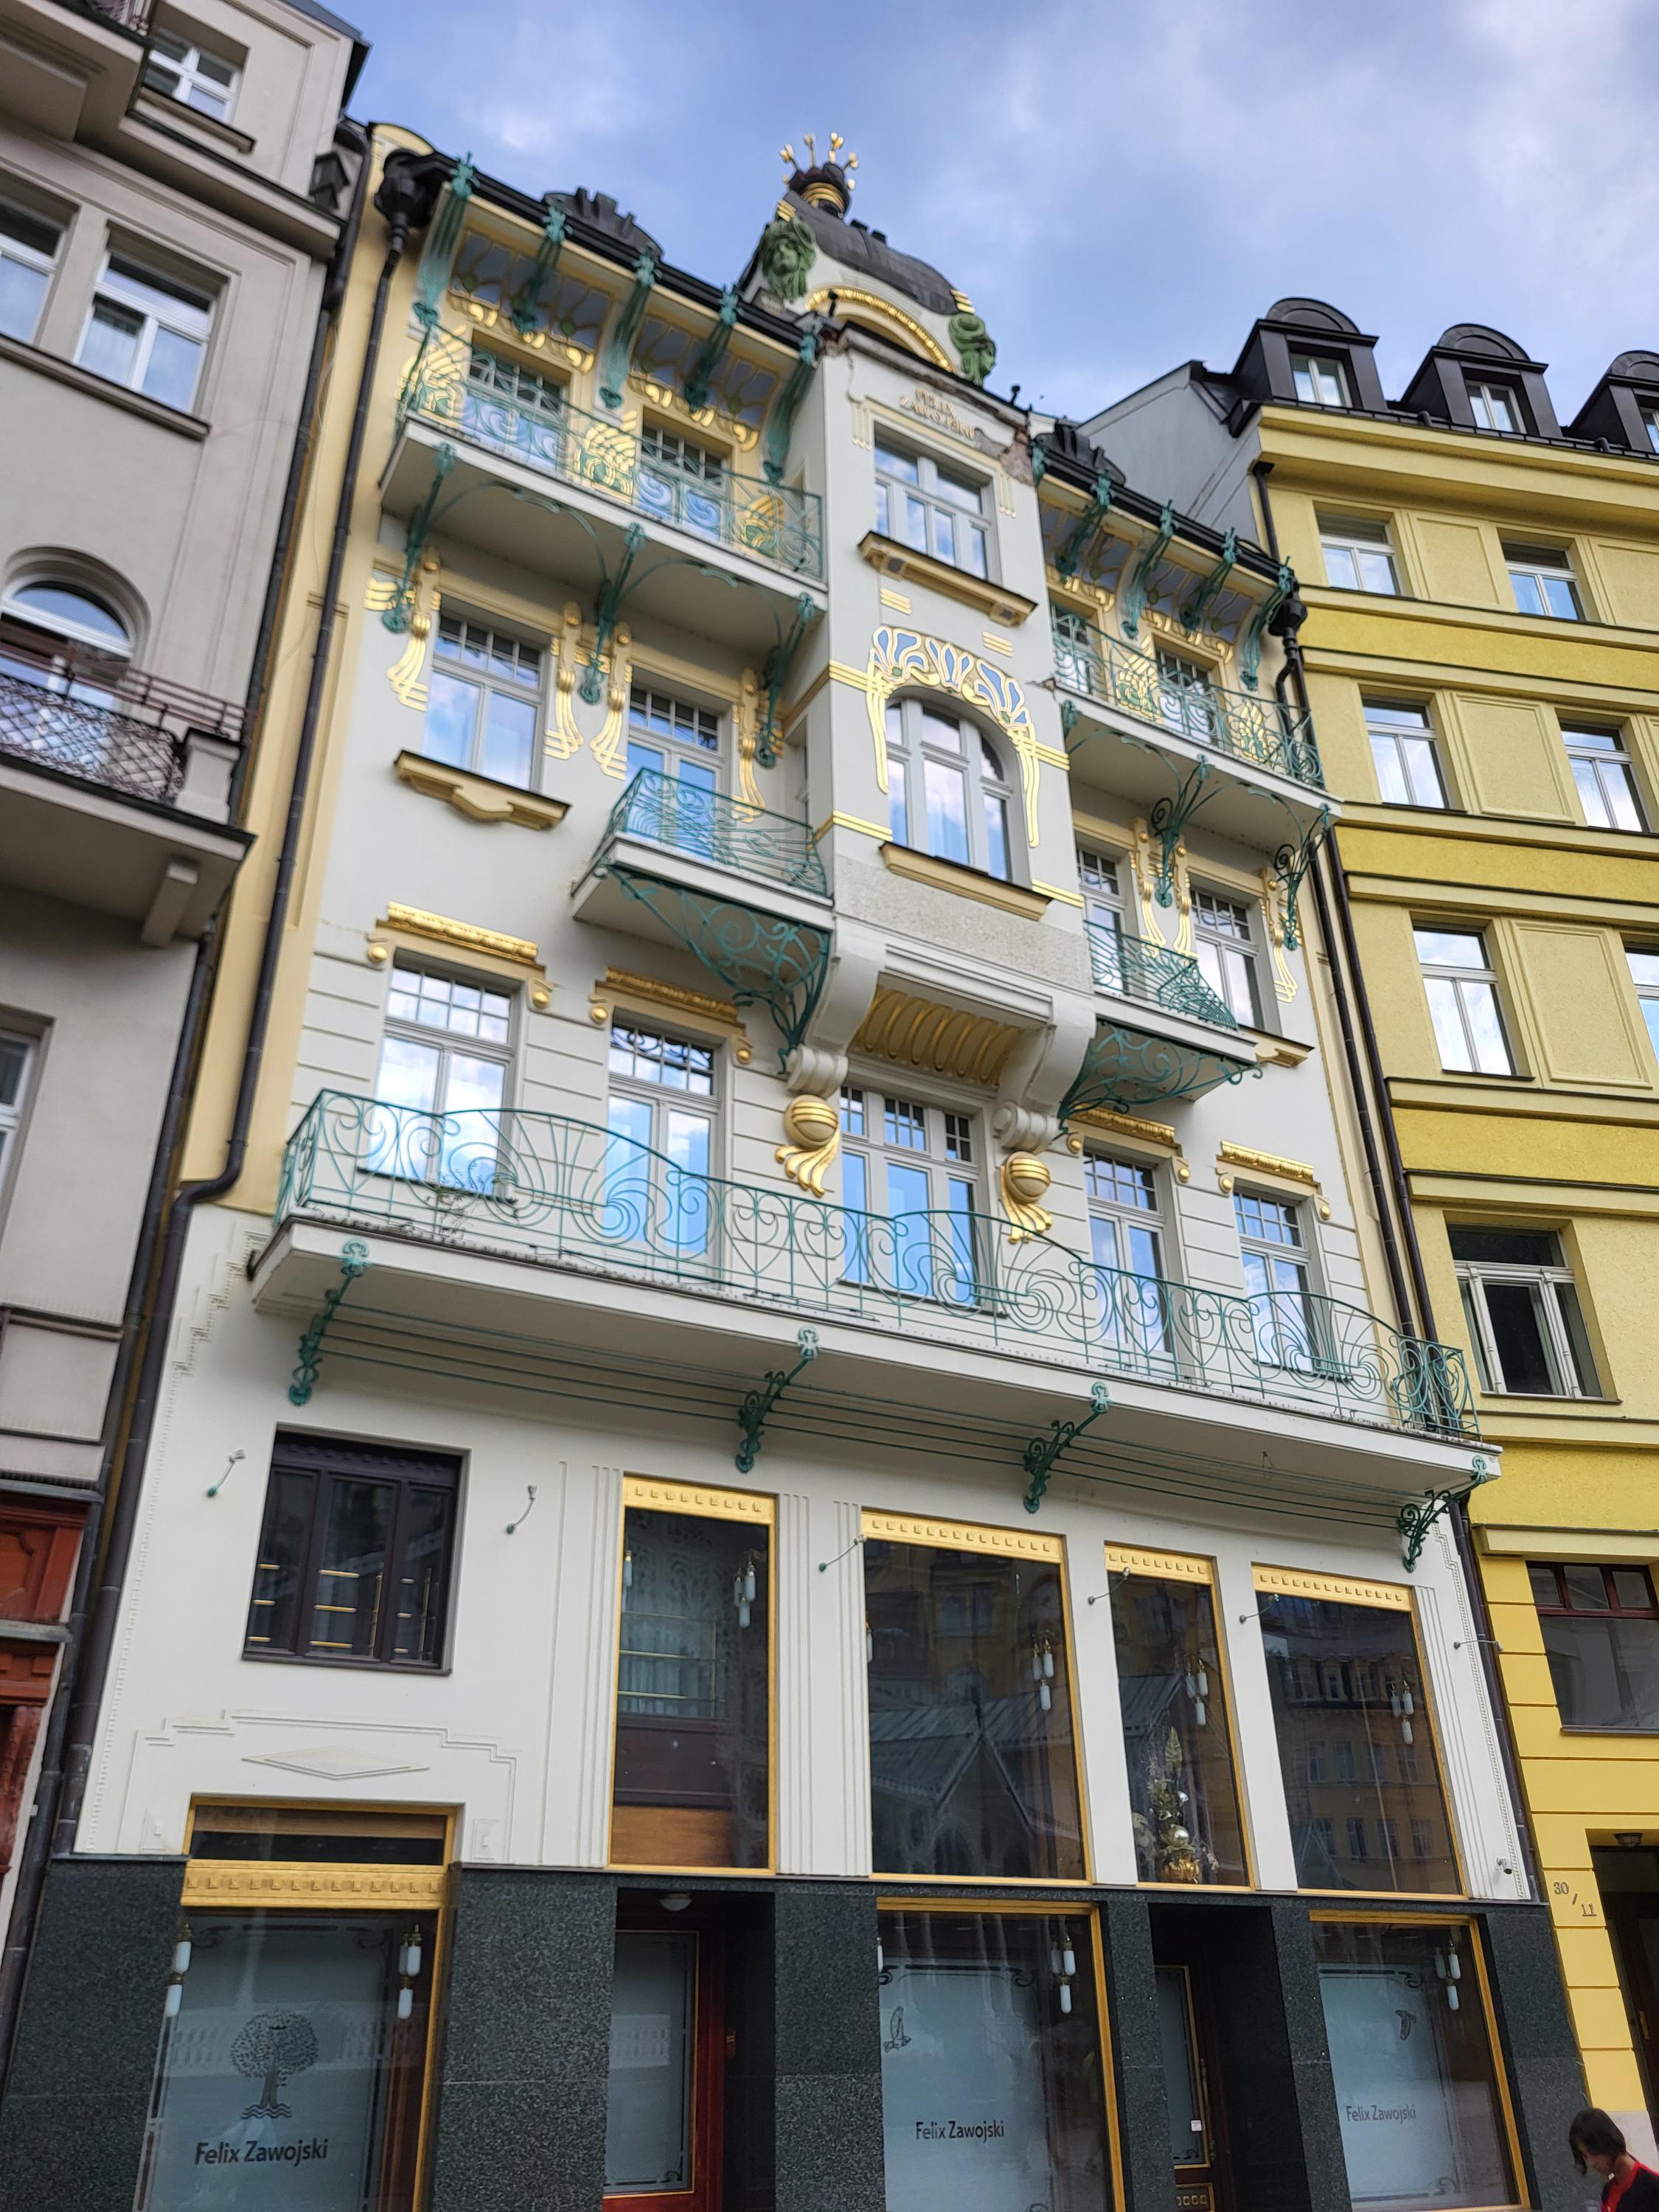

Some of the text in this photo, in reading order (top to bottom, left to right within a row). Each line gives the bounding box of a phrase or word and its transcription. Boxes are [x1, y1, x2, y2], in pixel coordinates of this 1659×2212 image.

[916, 389, 956, 417] FELIX
[1346, 2104, 1416, 2124] Felix Zawojski
[916, 2119, 1004, 2143] Felix Zawojski
[195, 2138, 329, 2168] Felix Zawojski
